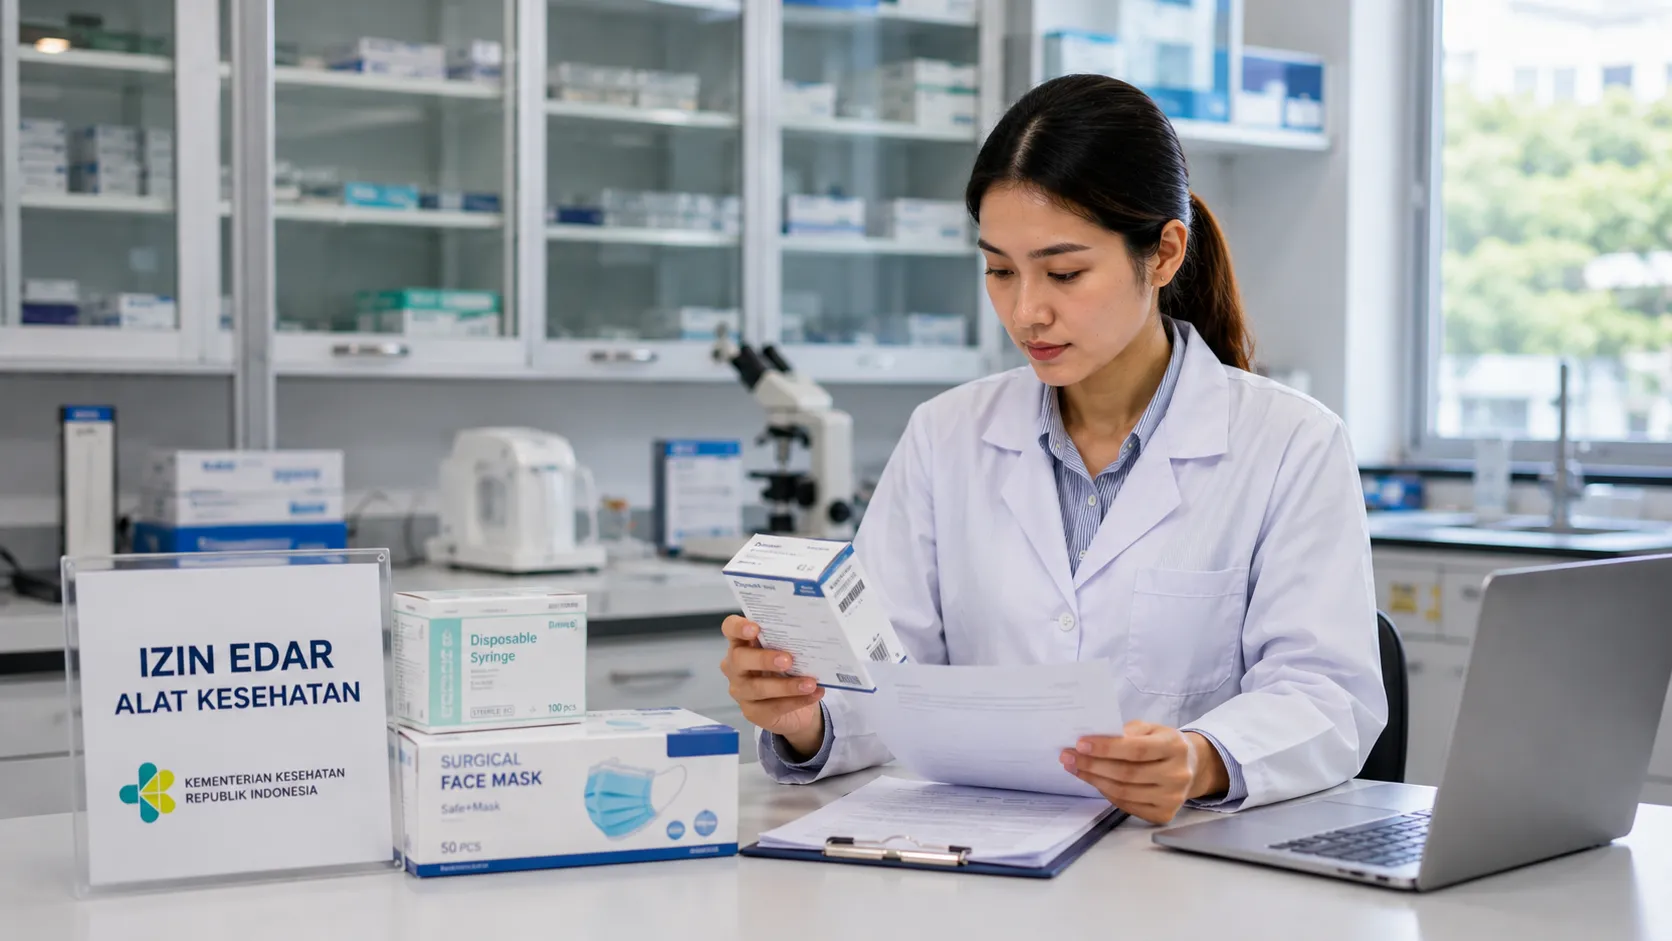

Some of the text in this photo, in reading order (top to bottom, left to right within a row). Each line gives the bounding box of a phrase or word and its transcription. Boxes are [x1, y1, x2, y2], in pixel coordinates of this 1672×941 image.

[470, 632, 537, 648] Disposable
[139, 639, 334, 678] IZIN EDAR
[470, 652, 516, 665] Syringe
[115, 681, 361, 715] ALAT KESEHATAN
[548, 702, 577, 714] 100 pcs
[440, 752, 522, 769] SURGICAL
[184, 767, 346, 788] KEMENTERIAN KESEHATAN
[440, 770, 543, 790] FACE MASK
[185, 785, 318, 804] REPUBLIK INDONESIA
[441, 841, 482, 854] 50 PCS
